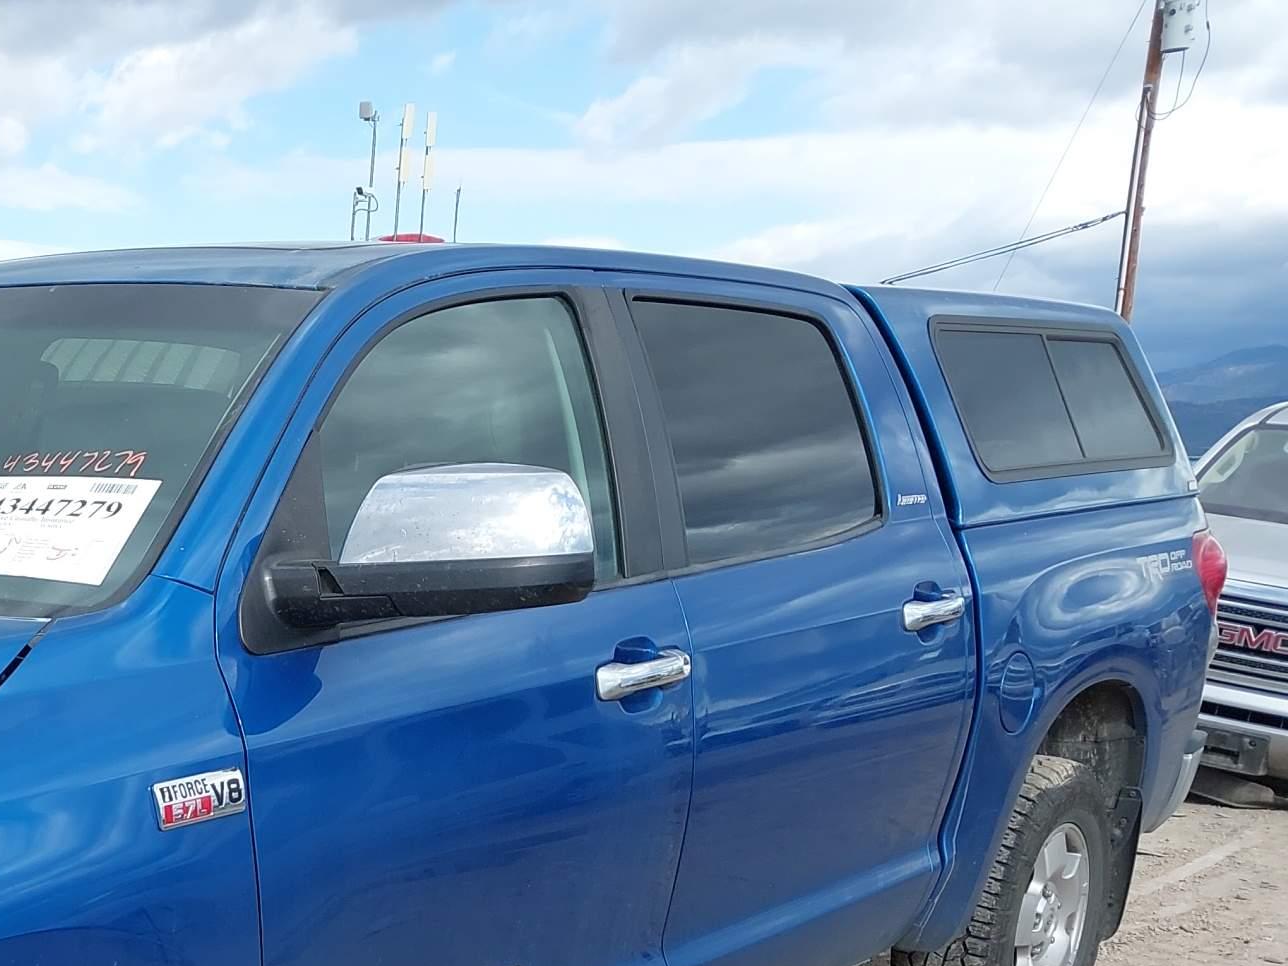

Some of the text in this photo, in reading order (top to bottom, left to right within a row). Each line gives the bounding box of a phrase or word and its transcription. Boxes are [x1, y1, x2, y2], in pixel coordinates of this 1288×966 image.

[3, 449, 148, 477] 43447279
[1135, 552, 1171, 583] TRD
[210, 778, 243, 808] V8
[172, 798, 209, 822] 5.7L
